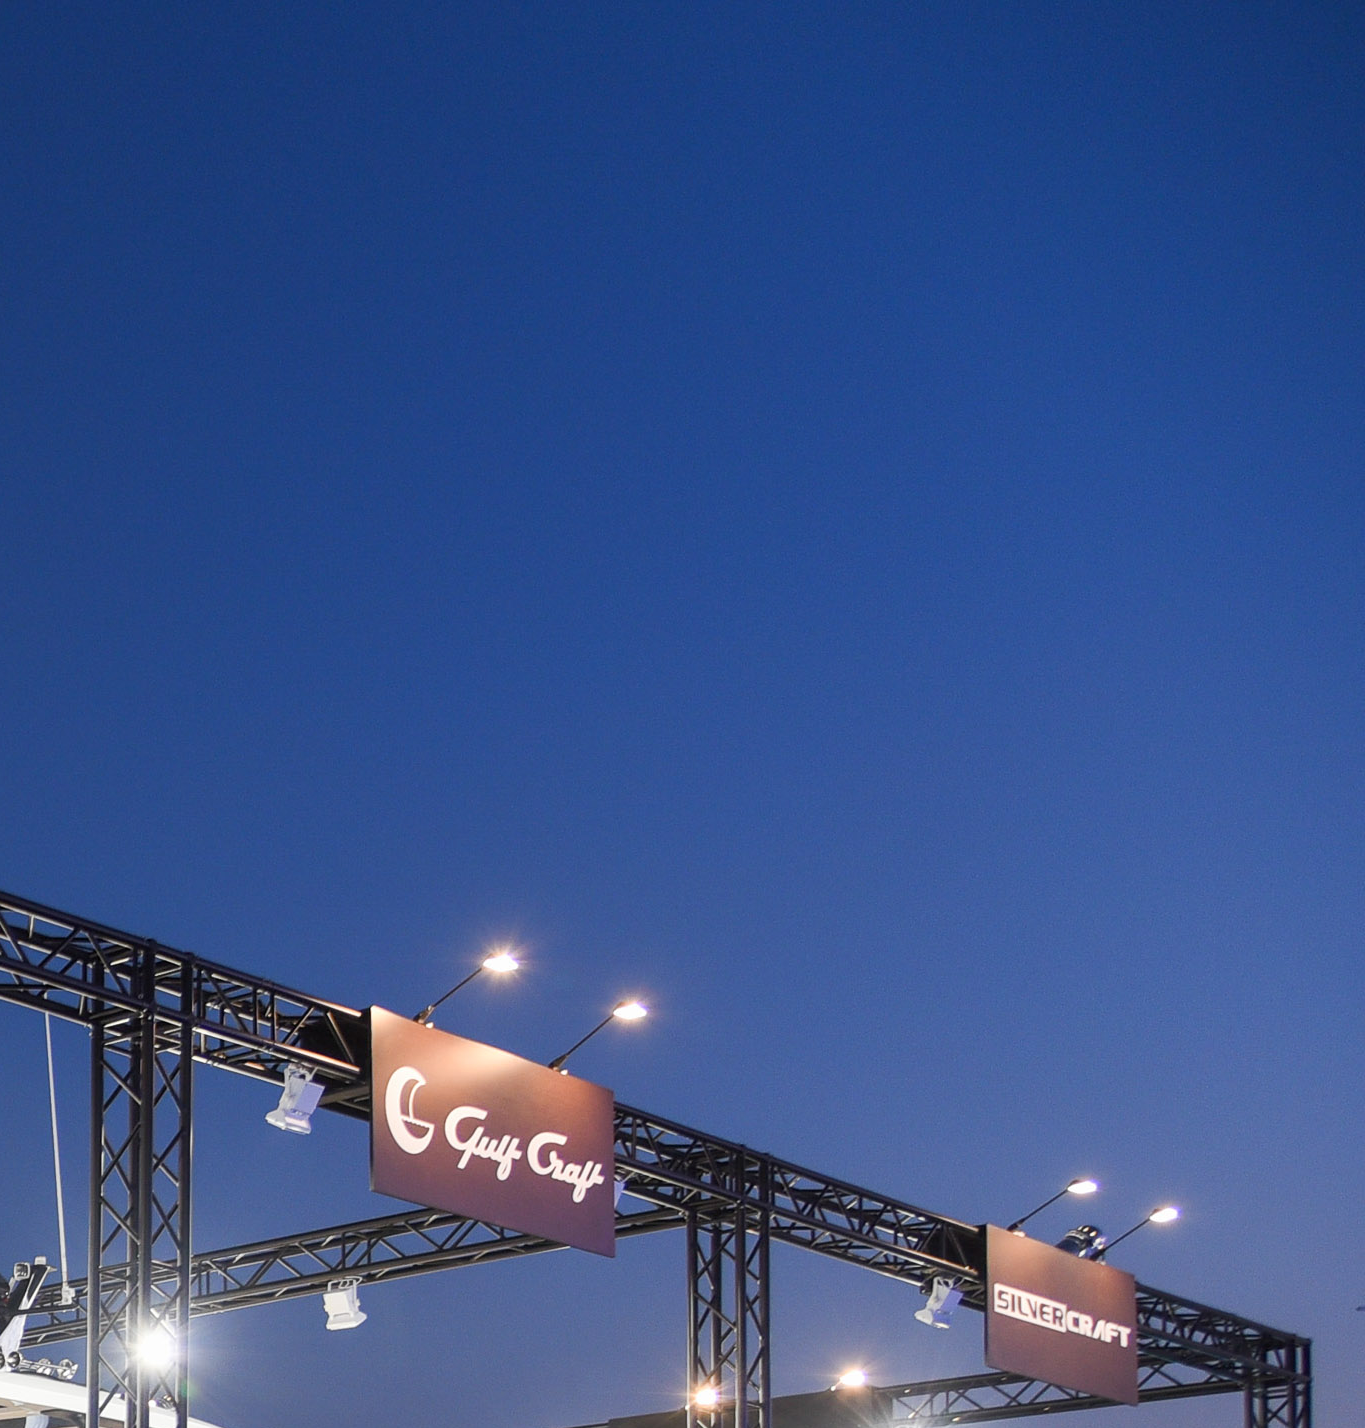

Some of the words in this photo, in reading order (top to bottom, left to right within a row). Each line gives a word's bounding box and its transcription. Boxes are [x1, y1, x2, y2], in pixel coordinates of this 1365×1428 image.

[444, 1105, 522, 1181] Gulf
[527, 1132, 604, 1204] Craft
[993, 1282, 1131, 1348] SILVERCRAFT
